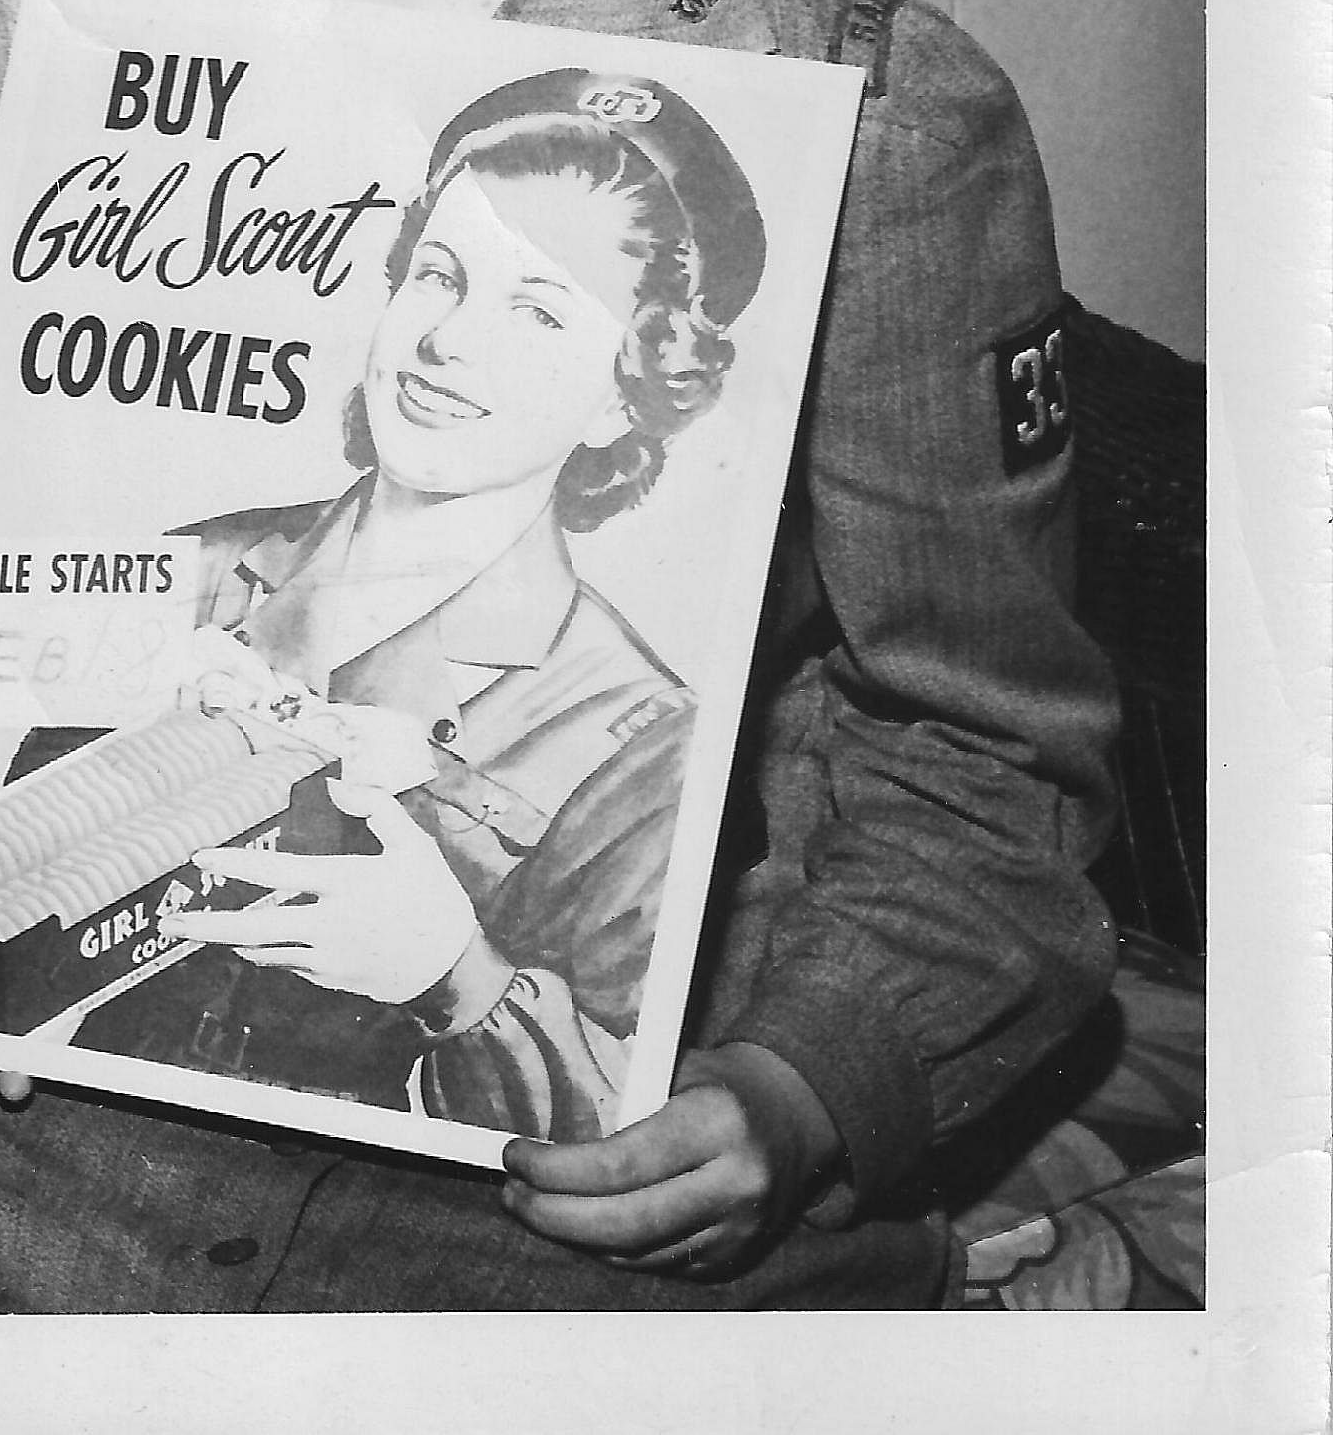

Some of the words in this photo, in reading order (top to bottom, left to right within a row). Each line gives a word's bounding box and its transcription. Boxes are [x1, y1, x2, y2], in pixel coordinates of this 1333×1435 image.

[104, 50, 250, 141] BUY
[12, 150, 191, 283] Girl
[155, 146, 396, 296] Scout
[20, 312, 312, 425] COOKIES
[50, 554, 175, 594] STARTS
[79, 902, 150, 960] GIRL
